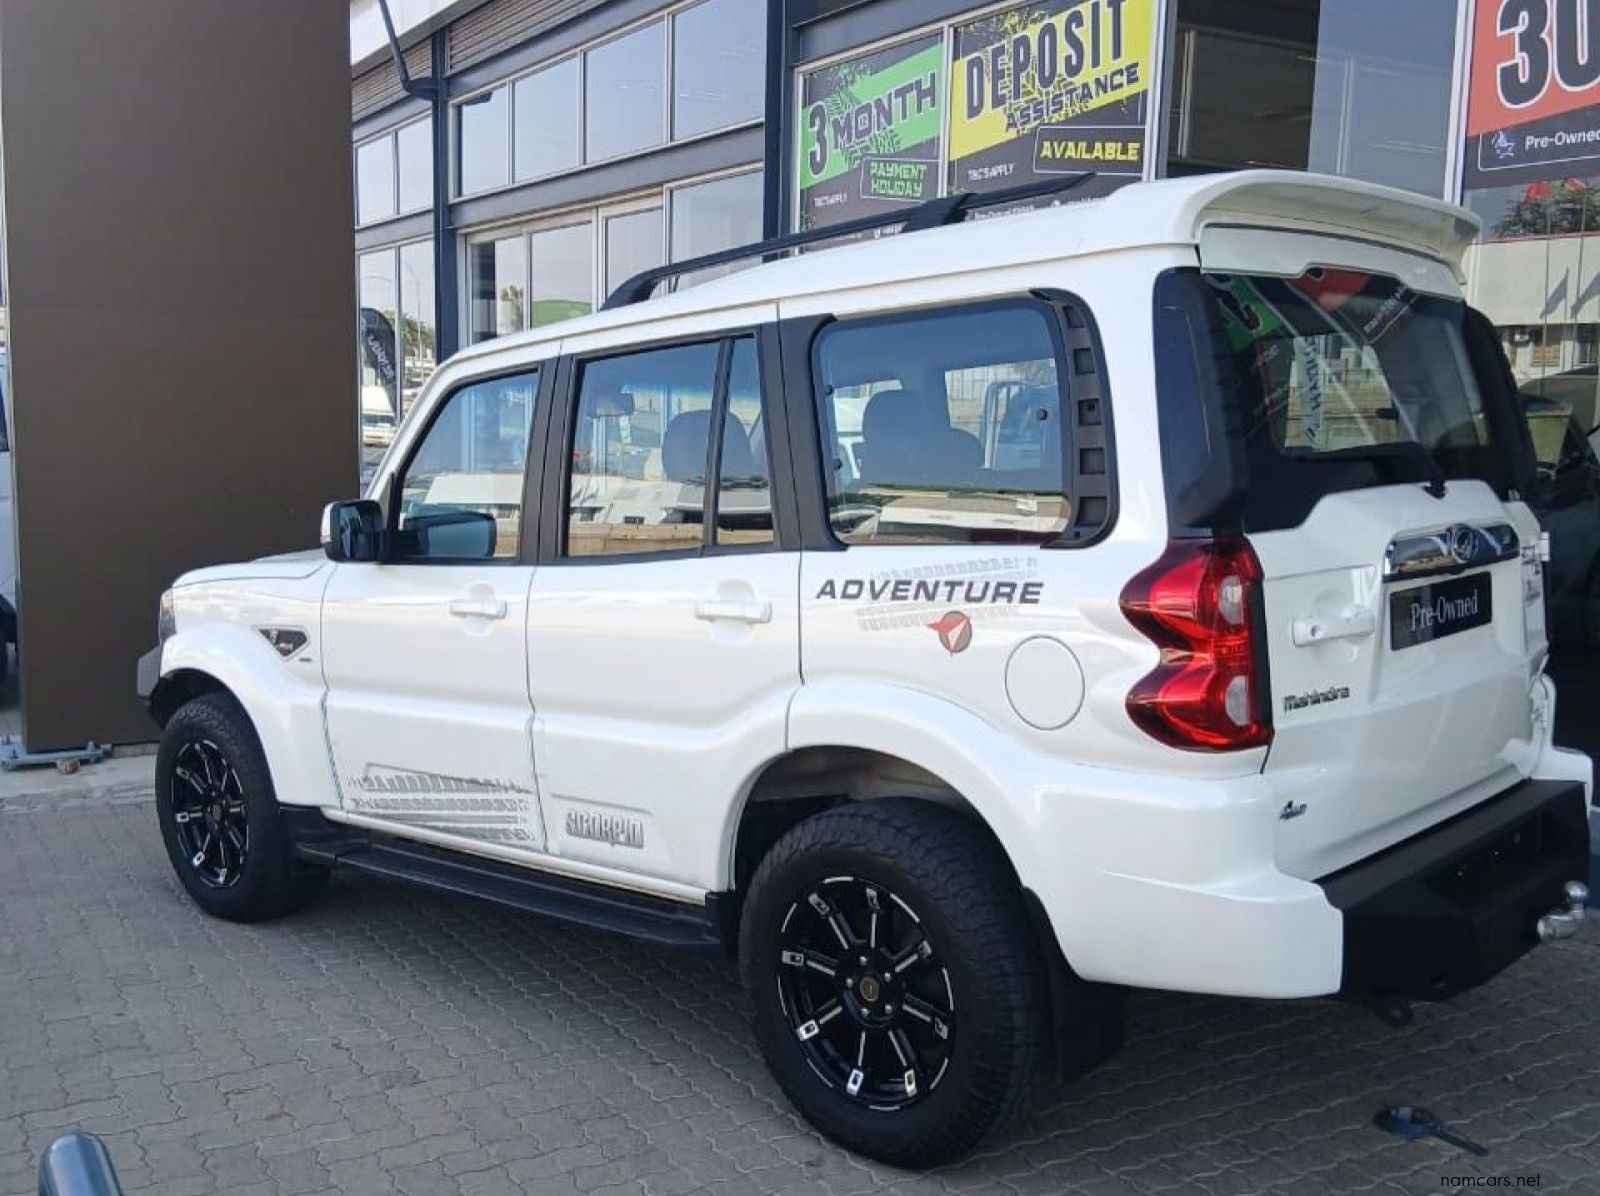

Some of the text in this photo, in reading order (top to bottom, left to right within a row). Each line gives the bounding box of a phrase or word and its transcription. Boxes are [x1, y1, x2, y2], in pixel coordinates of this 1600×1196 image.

[965, 0, 1127, 121] DEPOSIT
[1006, 62, 1140, 130] ASSISTANCE
[809, 74, 937, 177] 3 MONTH
[1040, 140, 1141, 161] AVAILABLE
[870, 162, 928, 180] PAYMENT
[871, 178, 923, 198] HOLIDAY
[815, 578, 1044, 604] ADVENTURE
[1410, 589, 1479, 632] Pre-Owned
